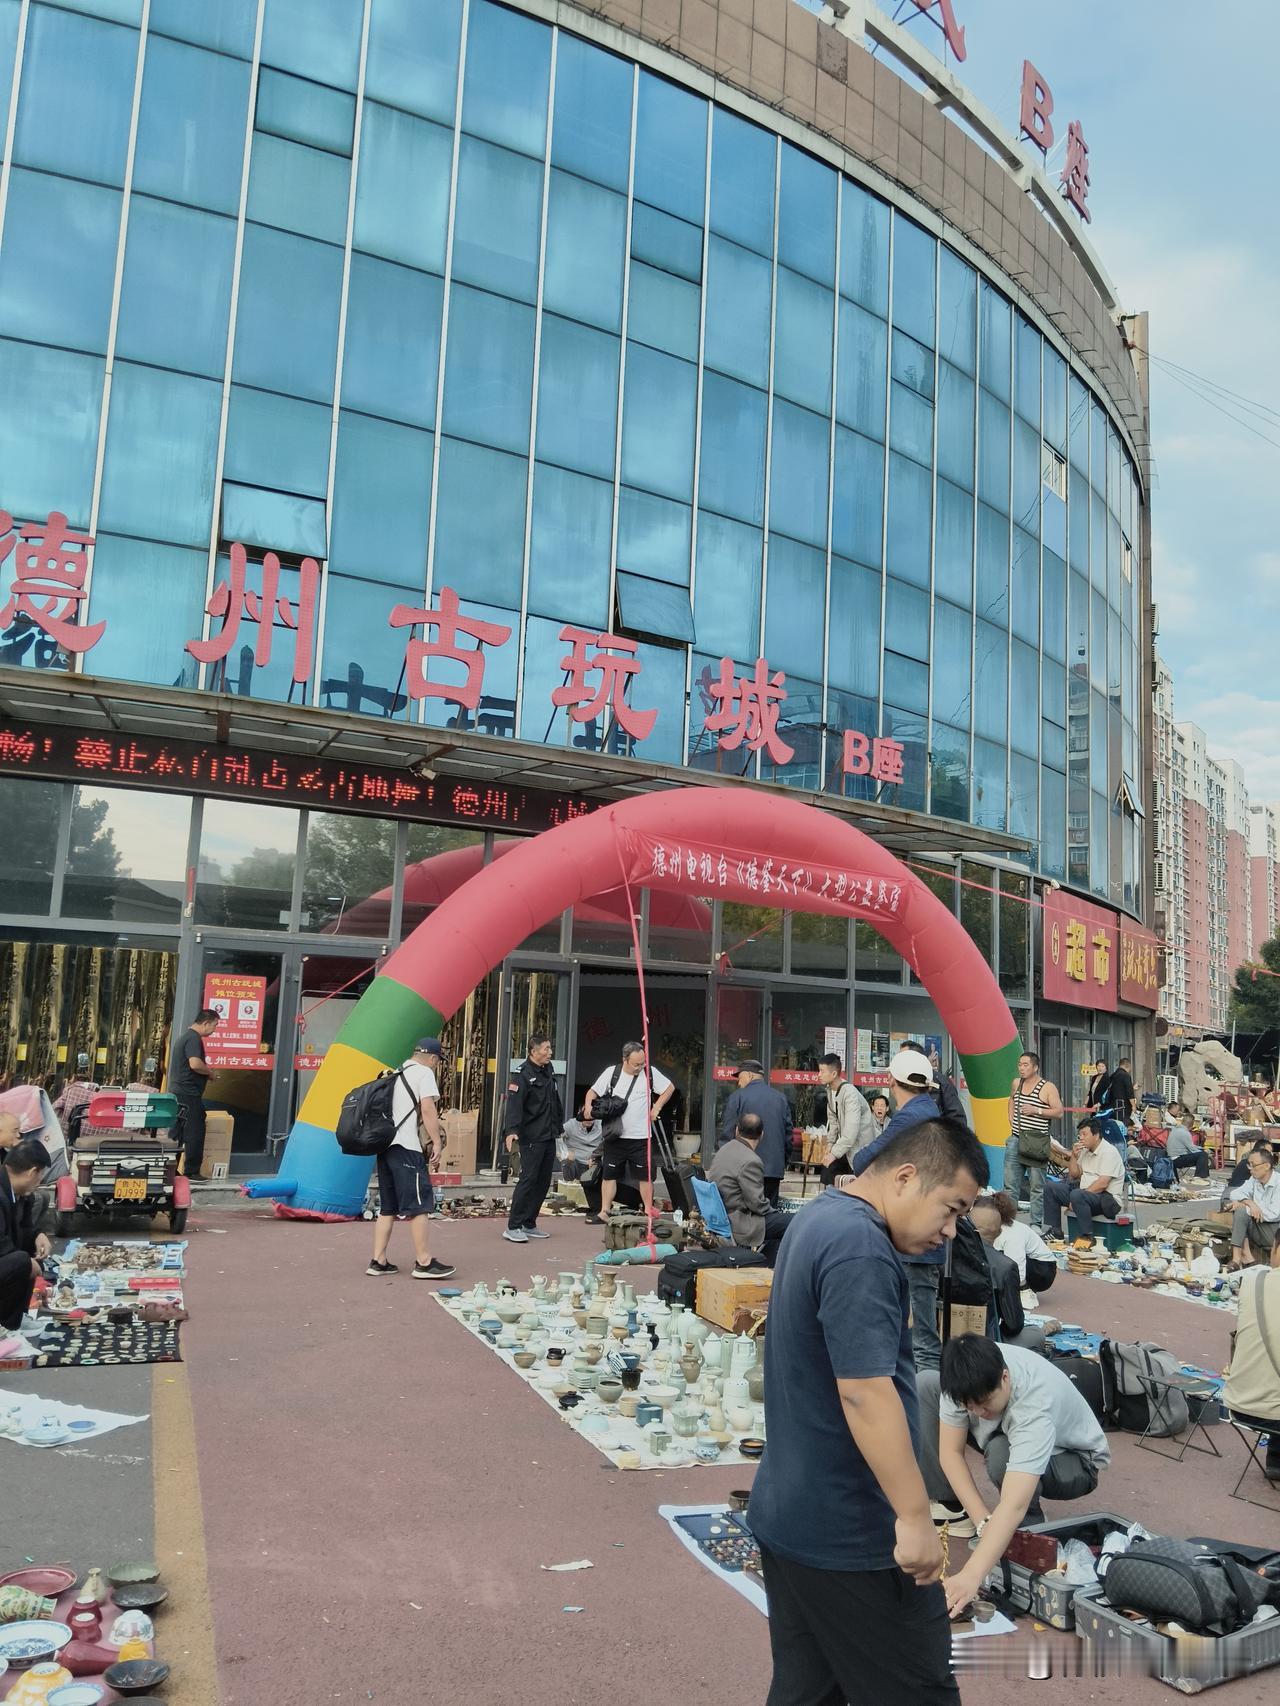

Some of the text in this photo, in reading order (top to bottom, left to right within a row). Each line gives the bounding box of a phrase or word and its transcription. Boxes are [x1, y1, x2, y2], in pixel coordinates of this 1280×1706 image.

[0, 511, 905, 784] 德州古玩城 B座
[210, 978, 263, 988] 德州古玩城
[1066, 918, 1111, 986] 超市
